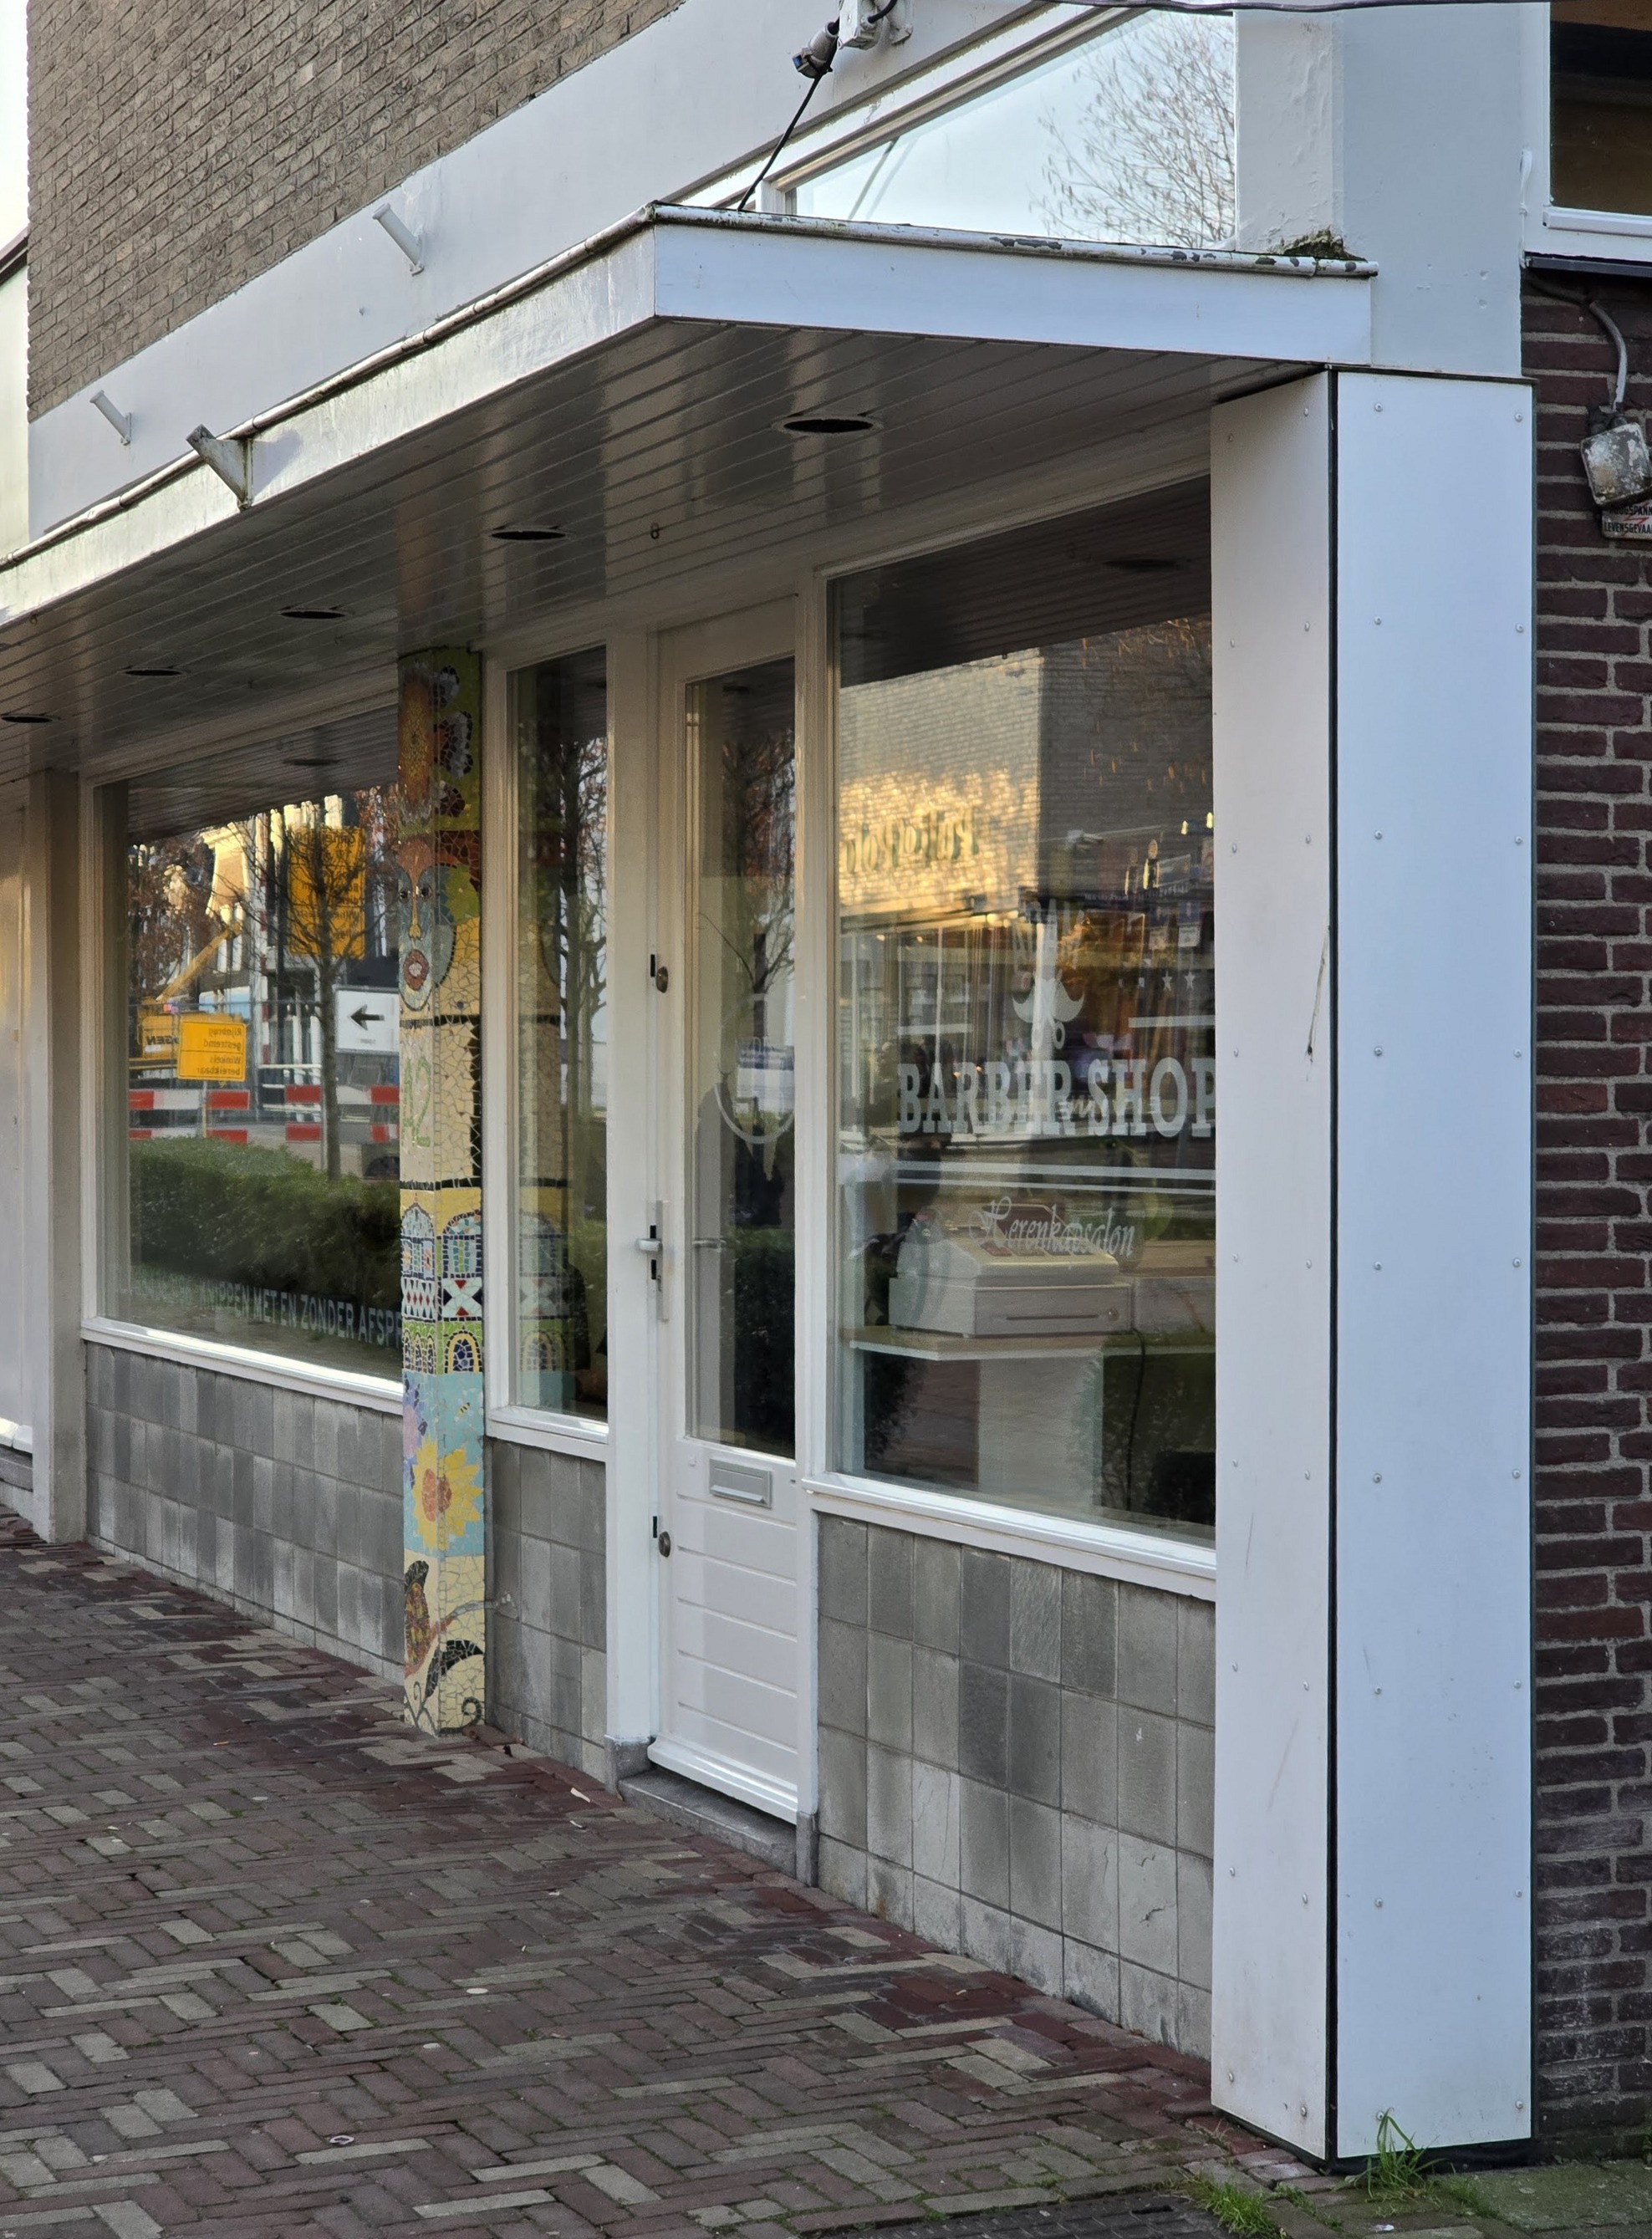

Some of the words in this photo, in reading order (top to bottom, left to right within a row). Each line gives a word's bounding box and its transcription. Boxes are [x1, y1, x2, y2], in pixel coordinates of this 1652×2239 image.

[1605, 522, 1652, 534] LEVENSGEVAA
[898, 1060, 1075, 1135] BARBER
[1088, 1058, 1216, 1137] SHOP
[253, 1288, 278, 1324] MET
[281, 1292, 297, 1328] EN
[300, 1294, 354, 1339] ZONDER
